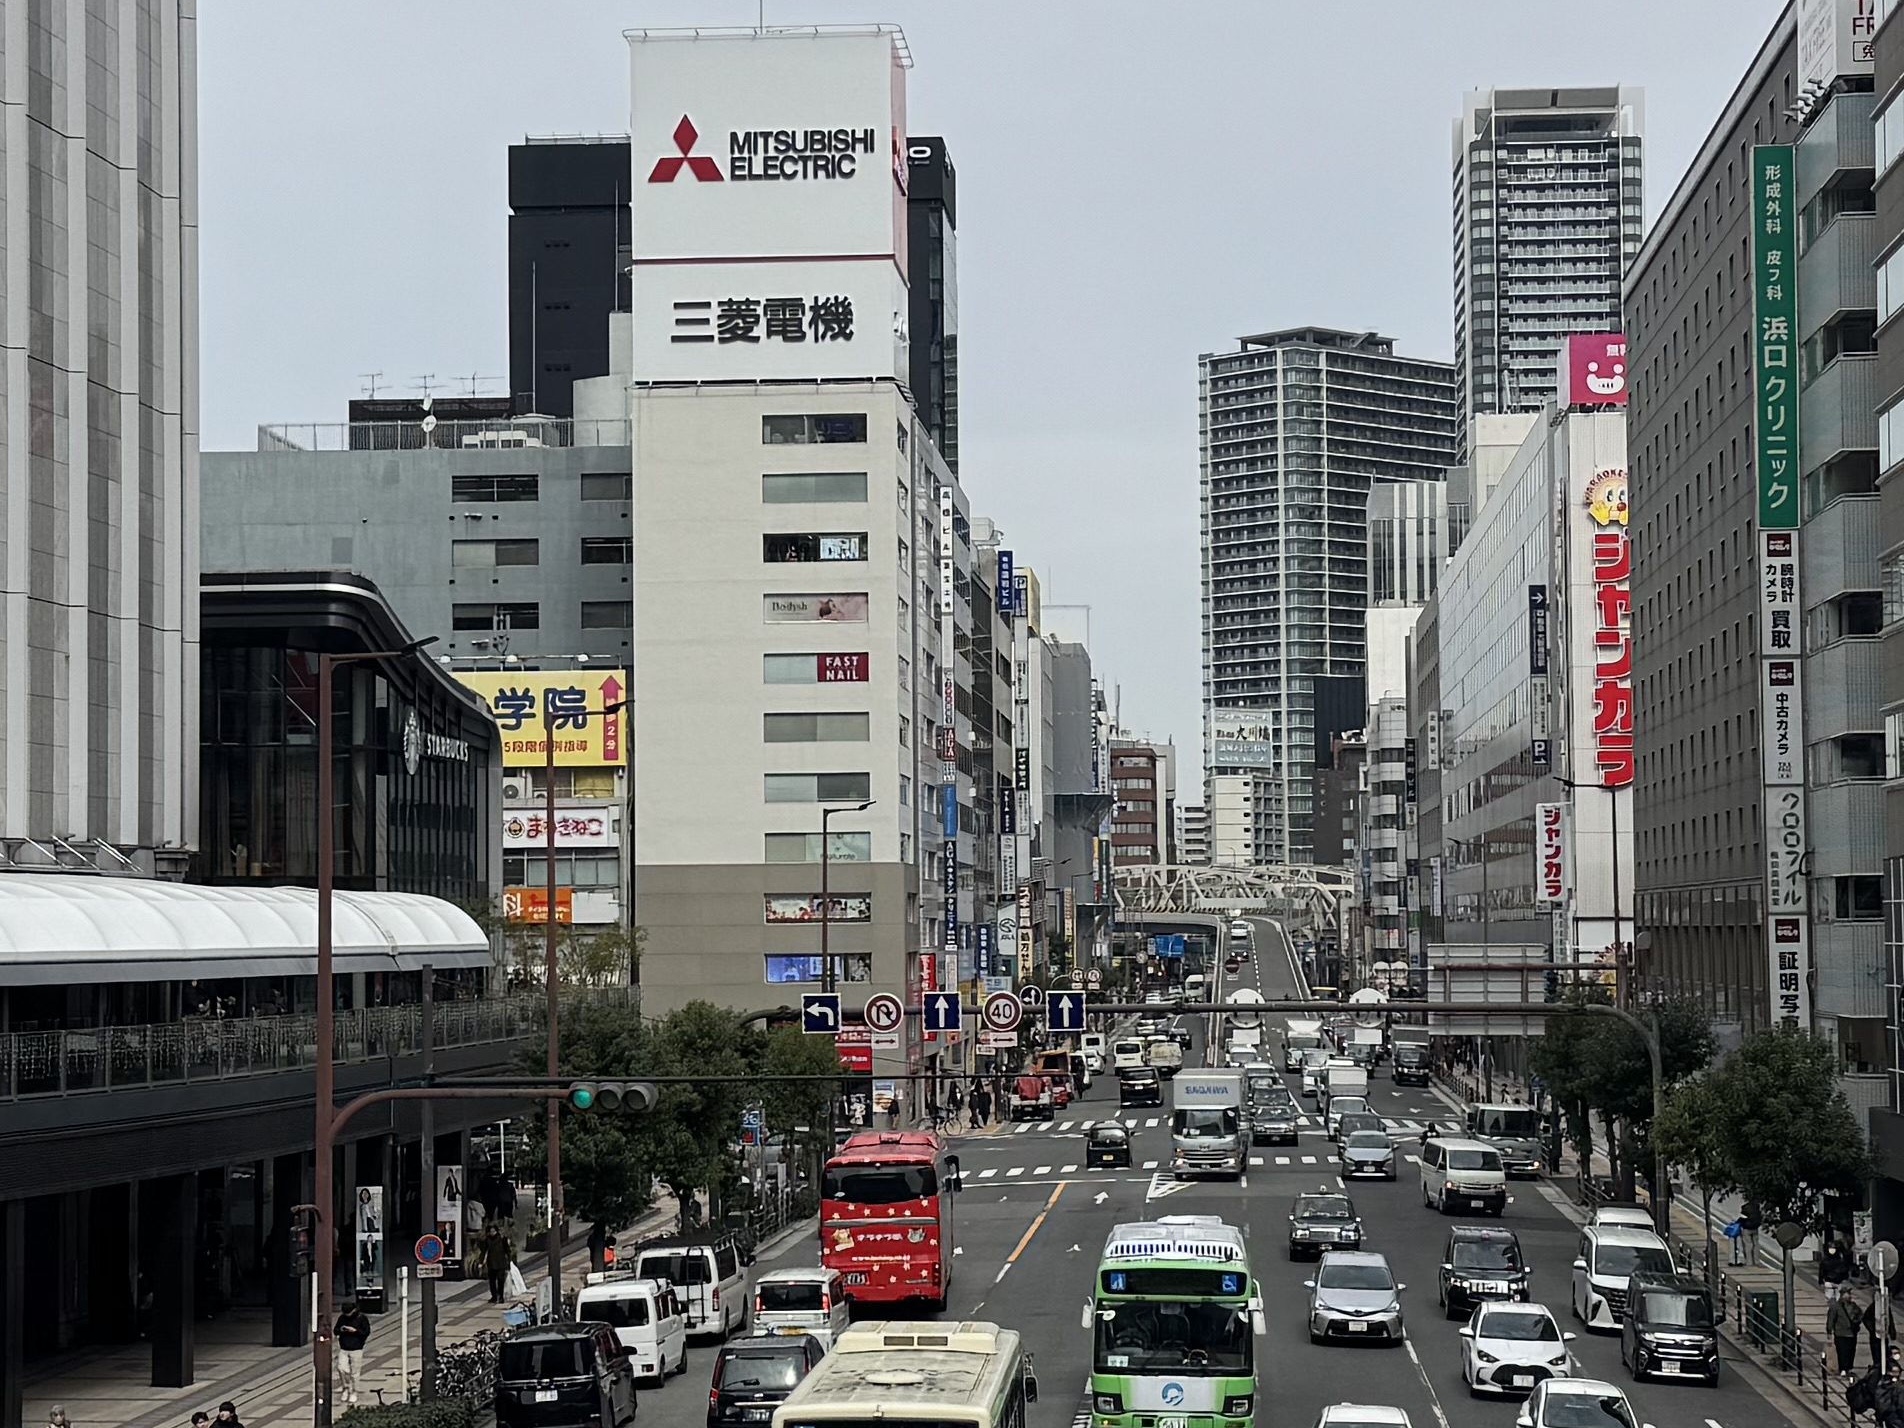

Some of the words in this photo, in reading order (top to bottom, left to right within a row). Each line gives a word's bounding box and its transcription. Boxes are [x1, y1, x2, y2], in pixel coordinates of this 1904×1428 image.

[729, 127, 876, 156] MITSUBISHI
[729, 154, 858, 182] ELECTRIC
[1764, 164, 1784, 235] 形成外科
[1765, 249, 1784, 302] 皮フ科
[669, 294, 856, 345] 三菱電機
[1770, 609, 1792, 650] 買取
[825, 656, 859, 668] FAST
[825, 670, 860, 681] NAIL
[1775, 691, 1790, 756] 中古カメラ
[427, 733, 469, 763] STARBUCKS
[1543, 806, 1564, 898] ジャンカラ
[991, 1003, 1013, 1020] 40
